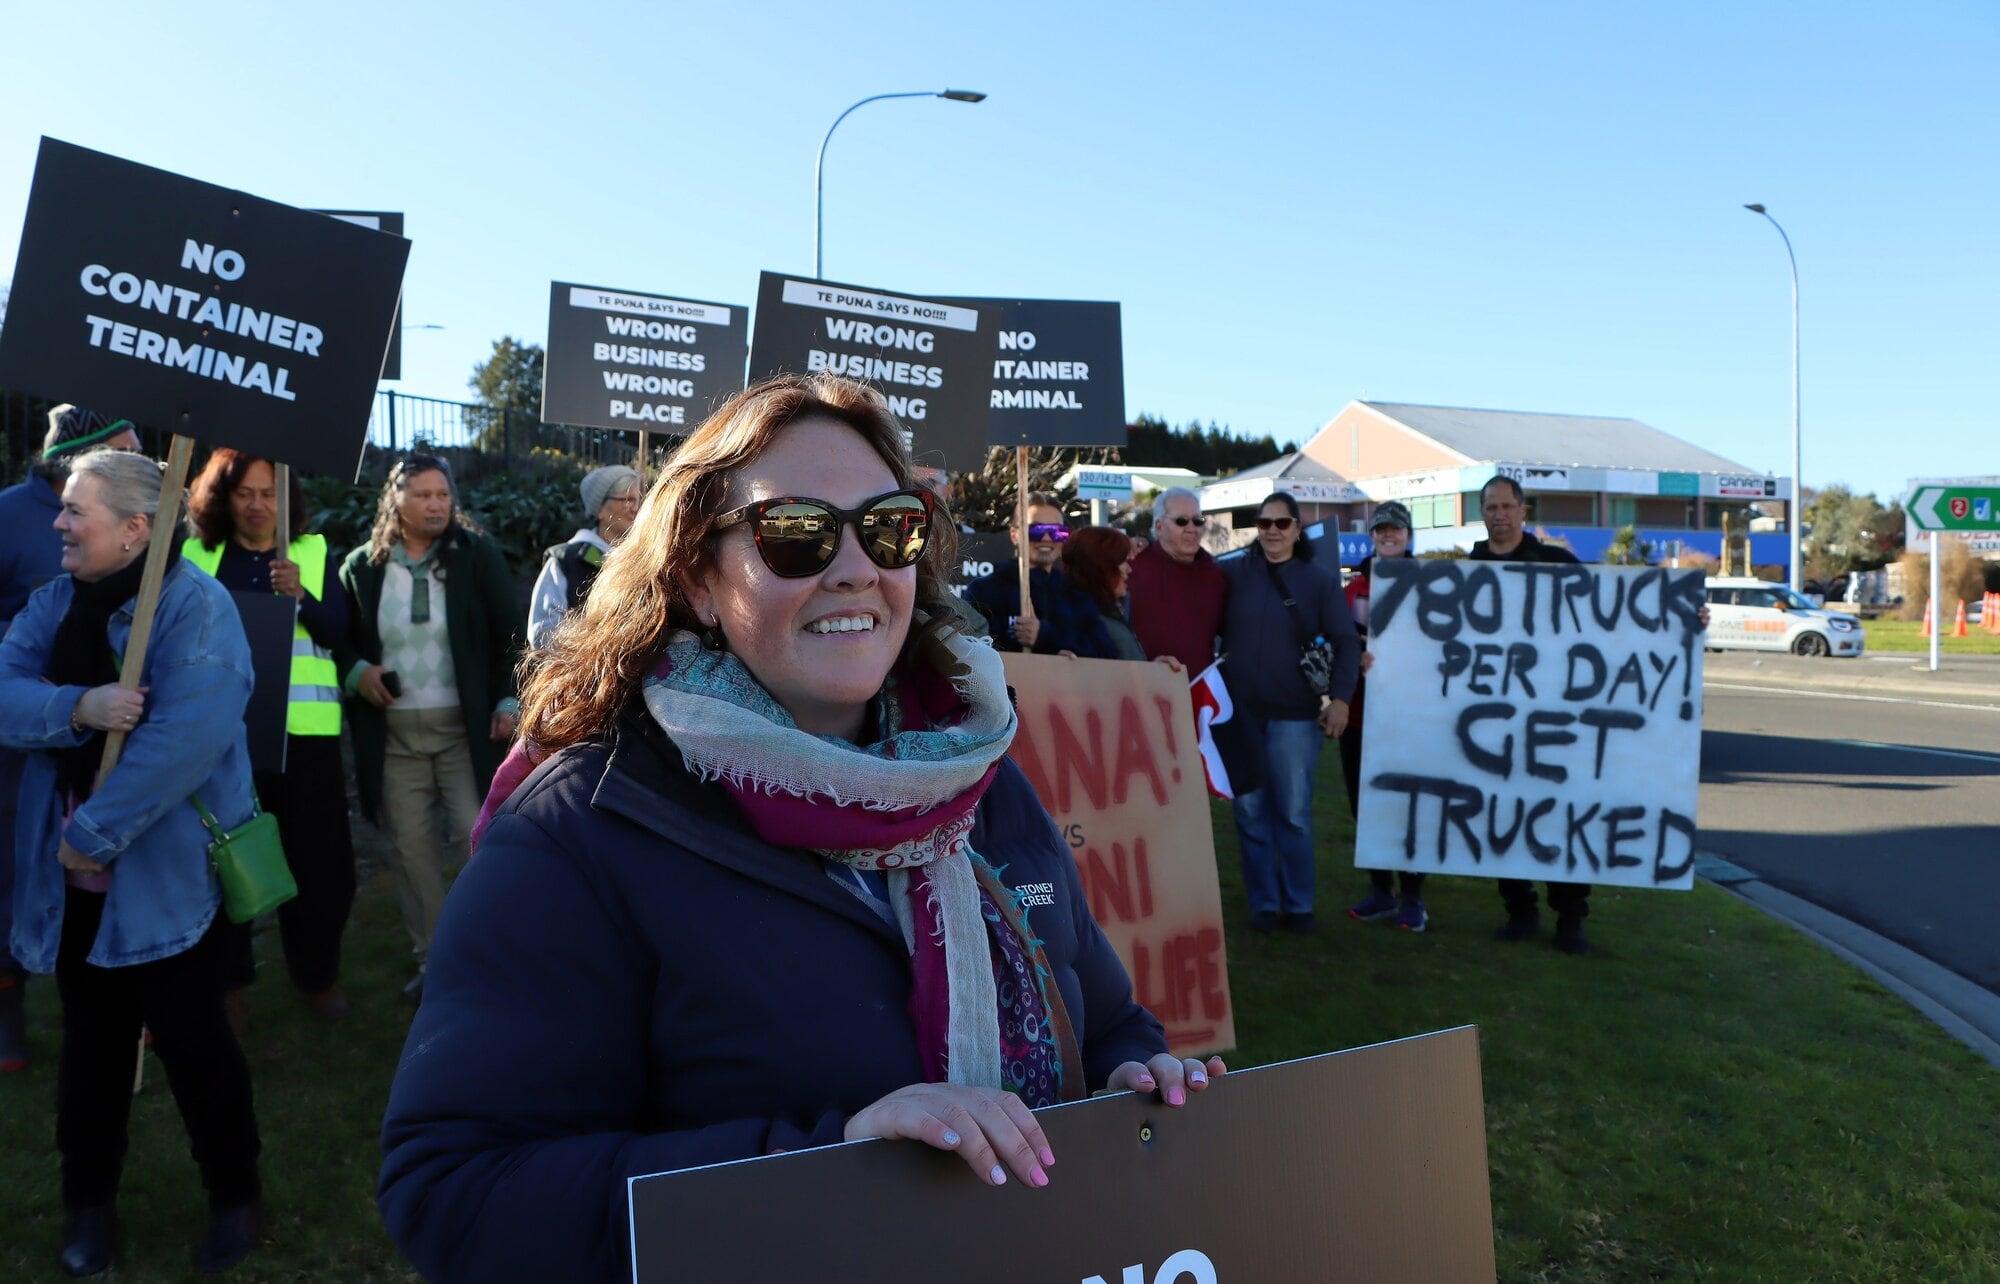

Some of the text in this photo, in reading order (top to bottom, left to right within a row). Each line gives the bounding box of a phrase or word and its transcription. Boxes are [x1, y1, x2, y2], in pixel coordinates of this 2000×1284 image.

[181, 239, 245, 281] NO
[80, 264, 323, 357] CONTAINER
[599, 295, 611, 304] TE
[614, 297, 644, 309] PUNA
[645, 302, 674, 313] SAYS
[818, 292, 947, 320] TE PUNA SAYS NO!!!!
[606, 316, 697, 344] WRONG
[825, 317, 935, 353] WRONG
[999, 331, 1036, 350] NO
[86, 314, 296, 402] TERMINAL
[594, 342, 706, 372] BUSINESS
[808, 349, 943, 388] BUSINESS
[994, 360, 1089, 380] TAINER
[603, 371, 694, 398] WRONG
[990, 389, 1082, 409] RMINAL
[610, 400, 685, 424] PLACE
[1954, 501, 1964, 513] 2
[962, 561, 994, 577] NO
[1368, 559, 1502, 641] 780
[1438, 632, 1694, 721] PER DAY!
[1455, 702, 1646, 784] GET
[1369, 771, 1696, 884] TRUCKED
[1015, 882, 1054, 895] STONEY
[1077, 836, 1154, 925] NI
[1021, 894, 1055, 907] CREEK
[1132, 928, 1226, 1022] LIFE
